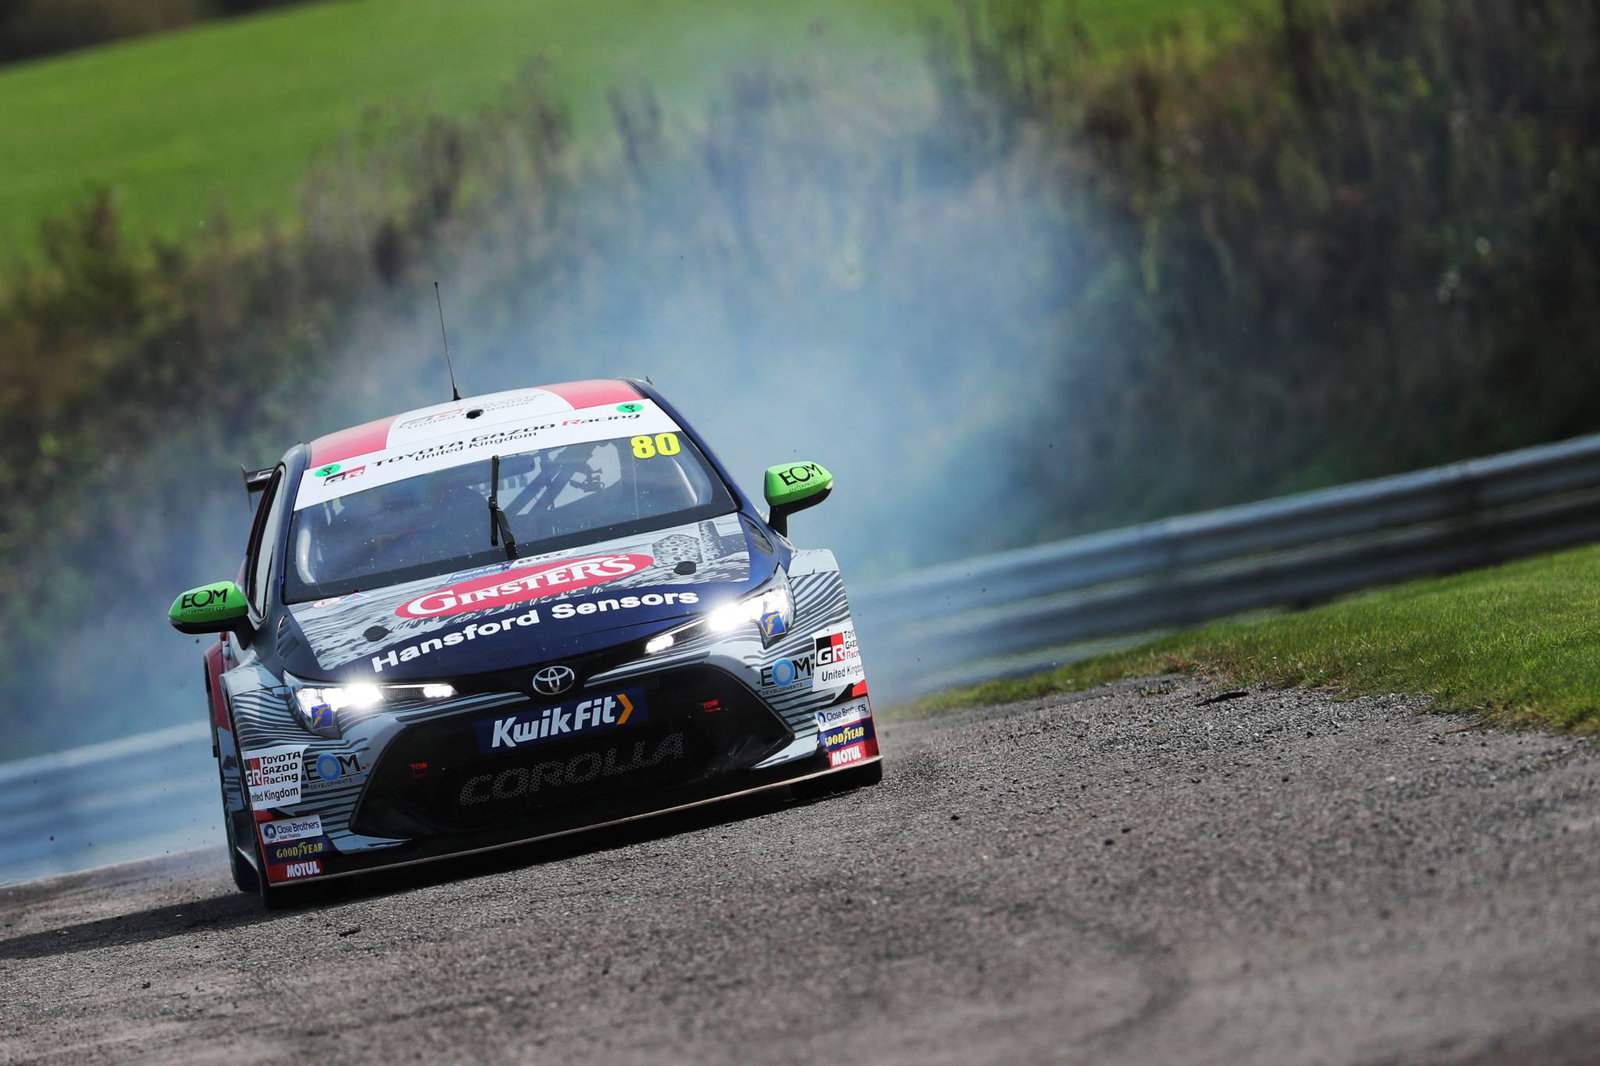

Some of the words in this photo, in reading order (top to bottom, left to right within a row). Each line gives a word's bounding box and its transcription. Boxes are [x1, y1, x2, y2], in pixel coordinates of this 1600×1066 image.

[372, 441, 464, 466] TOYOTA
[471, 423, 556, 443] GAZOO
[562, 414, 641, 427] Racing
[415, 445, 464, 461] United
[469, 431, 537, 450] Kingdom
[630, 432, 681, 459] 80
[778, 463, 823, 486] EOM
[407, 555, 637, 615] GINSTERS
[181, 588, 228, 609] EOM
[371, 609, 541, 674] Hansford
[551, 592, 700, 620] Sensors
[817, 644, 845, 667] GR
[760, 656, 811, 687] EOM
[822, 667, 845, 682] United
[703, 700, 718, 709] TOW
[826, 712, 841, 721] Close
[261, 751, 301, 765] TOYOTA
[832, 746, 861, 766] MOTUL
[262, 762, 298, 775] GAZOO
[410, 761, 428, 771] TOW
[459, 731, 685, 806] COROLLA
[263, 773, 299, 785] Racing
[264, 787, 299, 801] Kingdom
[277, 825, 292, 834] Close
[292, 821, 320, 832] Brothers
[276, 842, 323, 859] GOODYEAR
[286, 861, 320, 878] MOTUL
